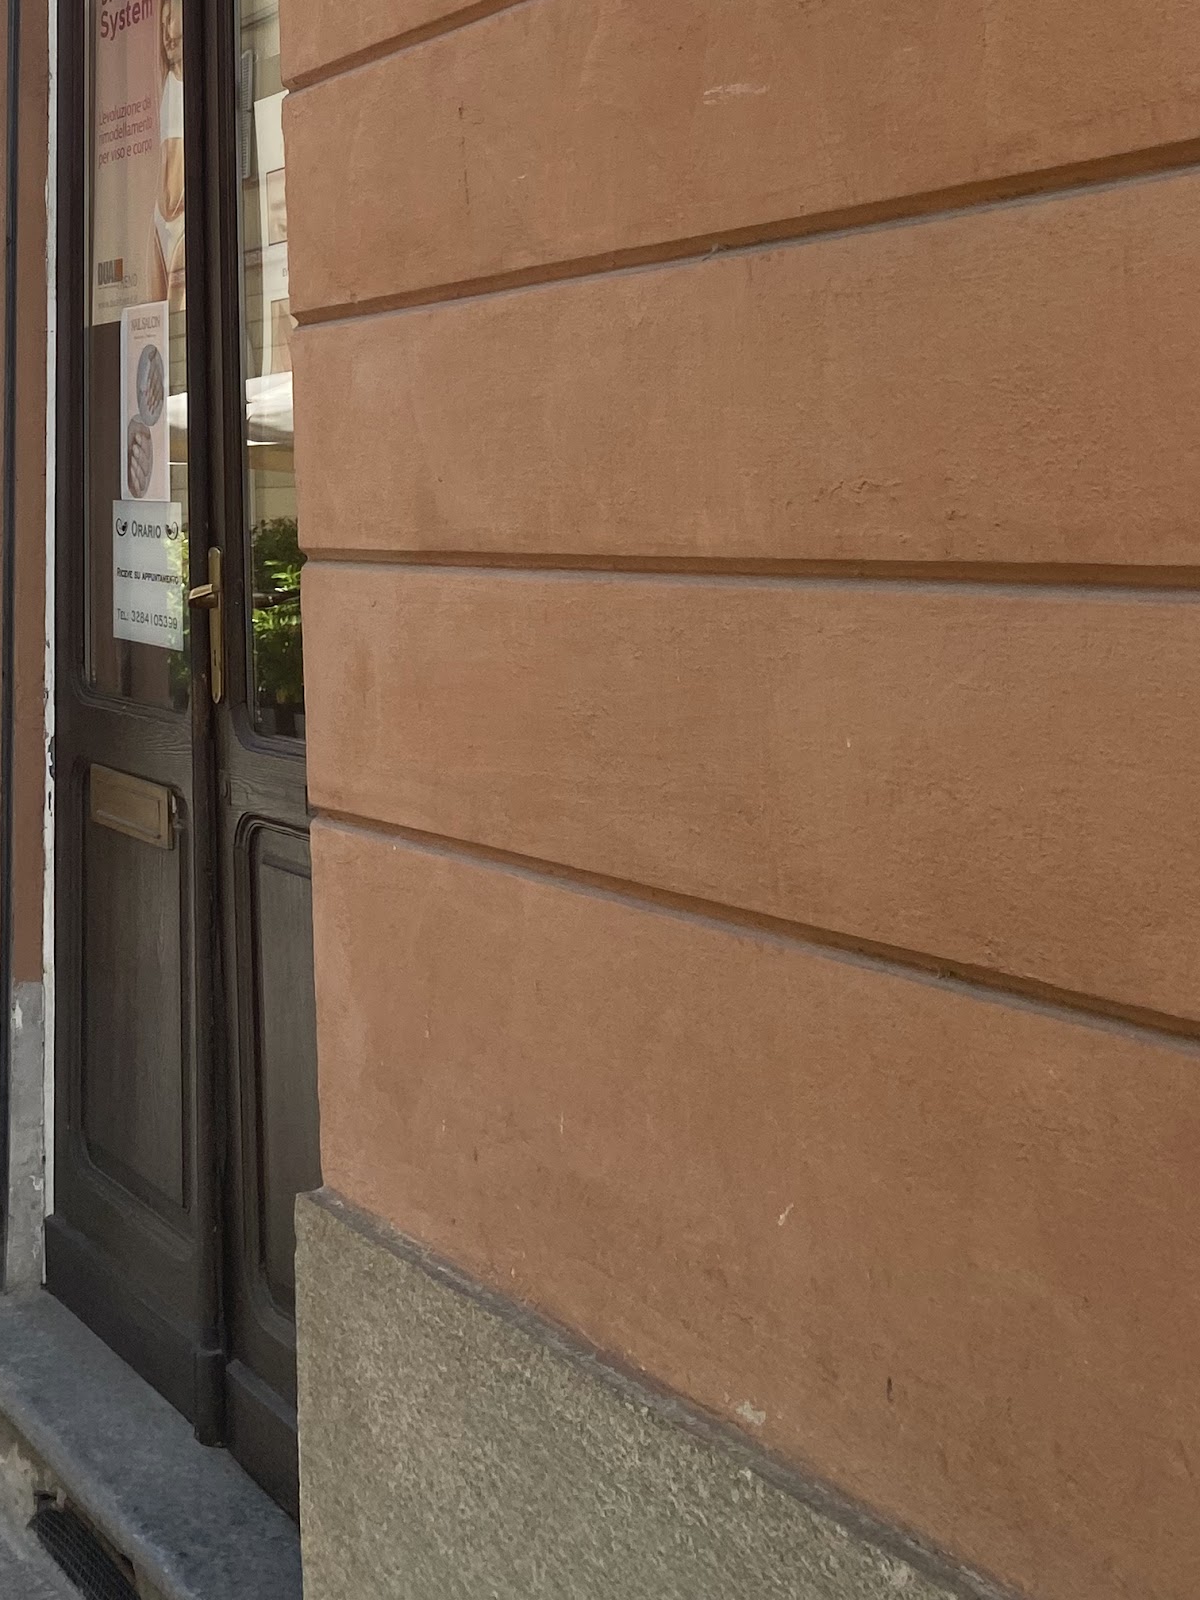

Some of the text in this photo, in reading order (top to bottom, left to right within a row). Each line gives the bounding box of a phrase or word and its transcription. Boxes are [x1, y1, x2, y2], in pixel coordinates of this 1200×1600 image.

[98, 138, 152, 169] per viso e corpo
[131, 520, 161, 539] ORARIO
